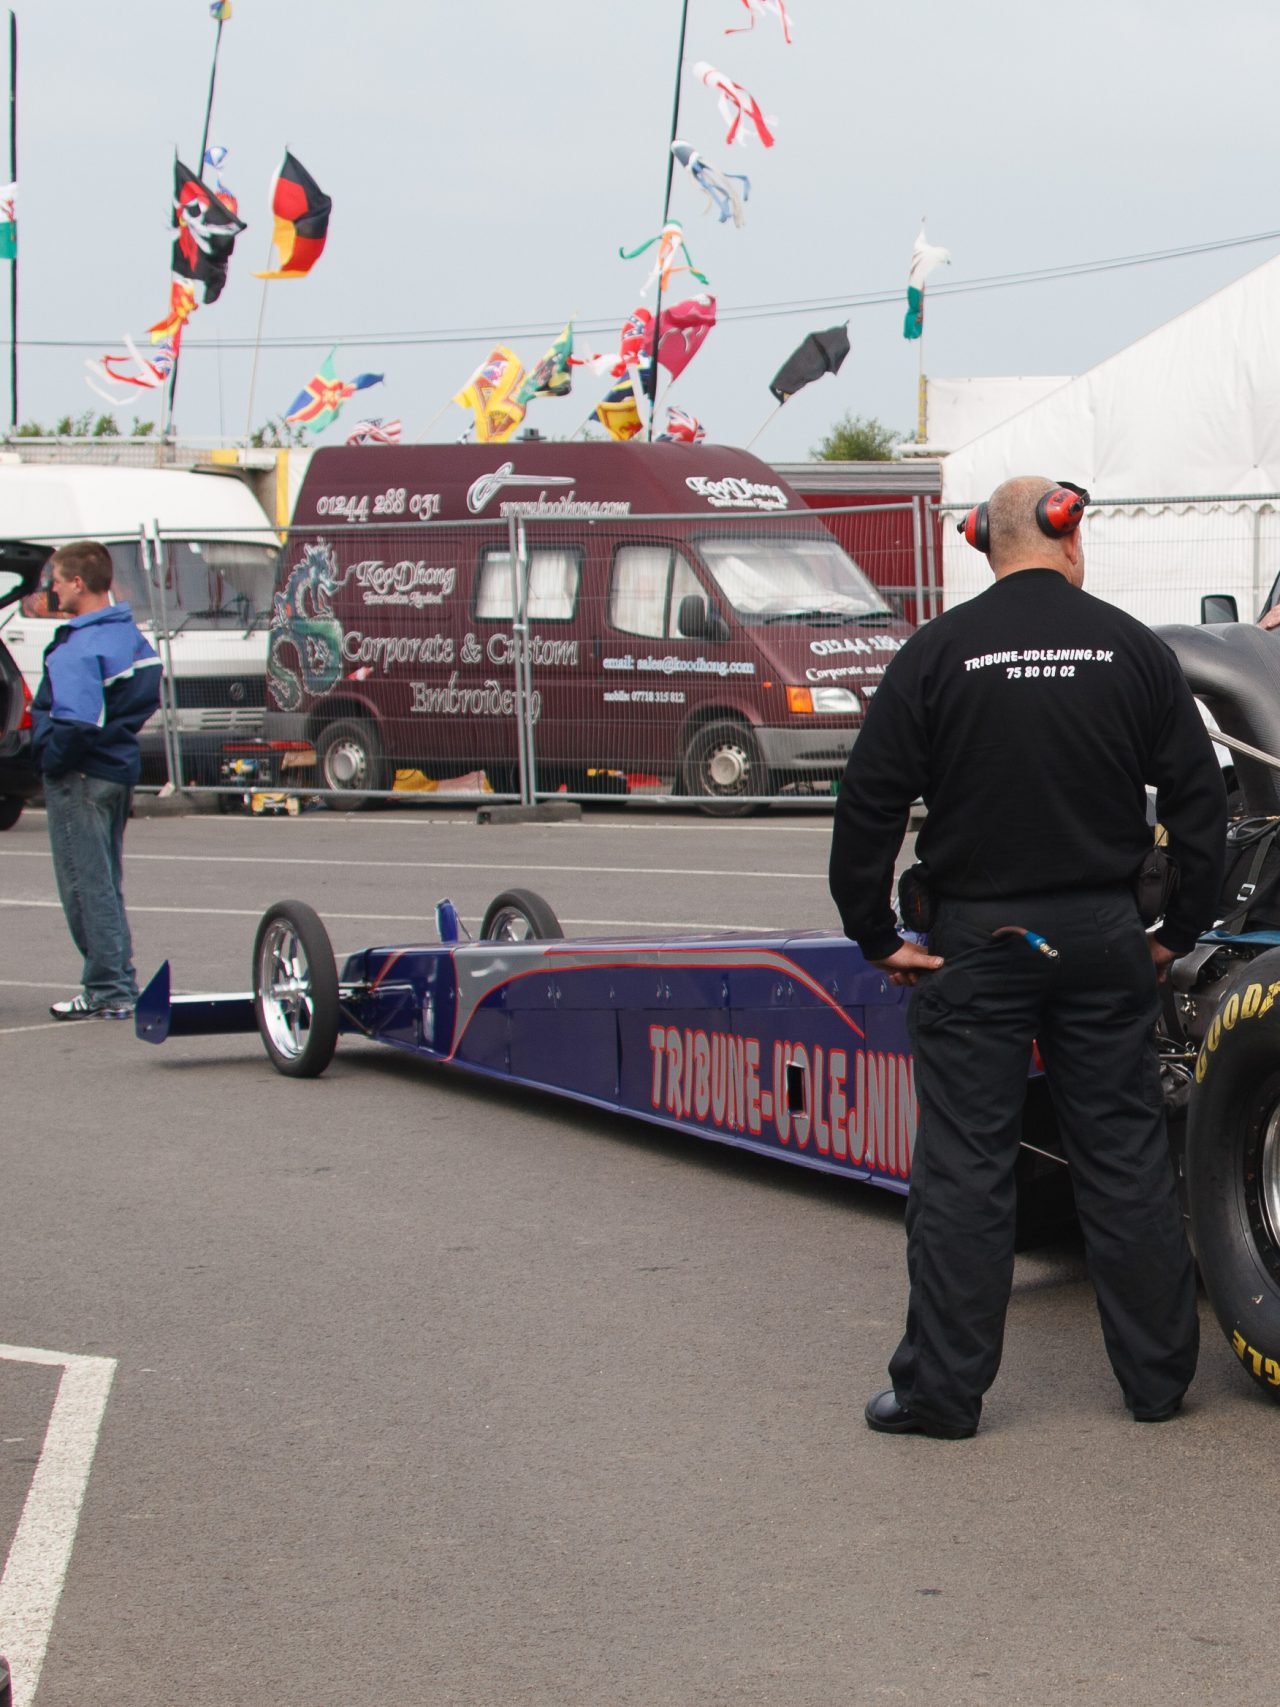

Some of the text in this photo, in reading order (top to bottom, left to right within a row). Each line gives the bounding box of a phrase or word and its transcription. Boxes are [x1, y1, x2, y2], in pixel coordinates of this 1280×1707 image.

[316, 488, 441, 522] 01244 288 031
[342, 631, 454, 673] Corporate
[460, 633, 483, 664] &
[964, 649, 1114, 671] TRIBUNE-UDLEJNING.DK
[603, 655, 755, 676] email: sales@koodhong.com
[806, 663, 863, 681] Corporate
[1006, 665, 1076, 679] 75 80 01 02
